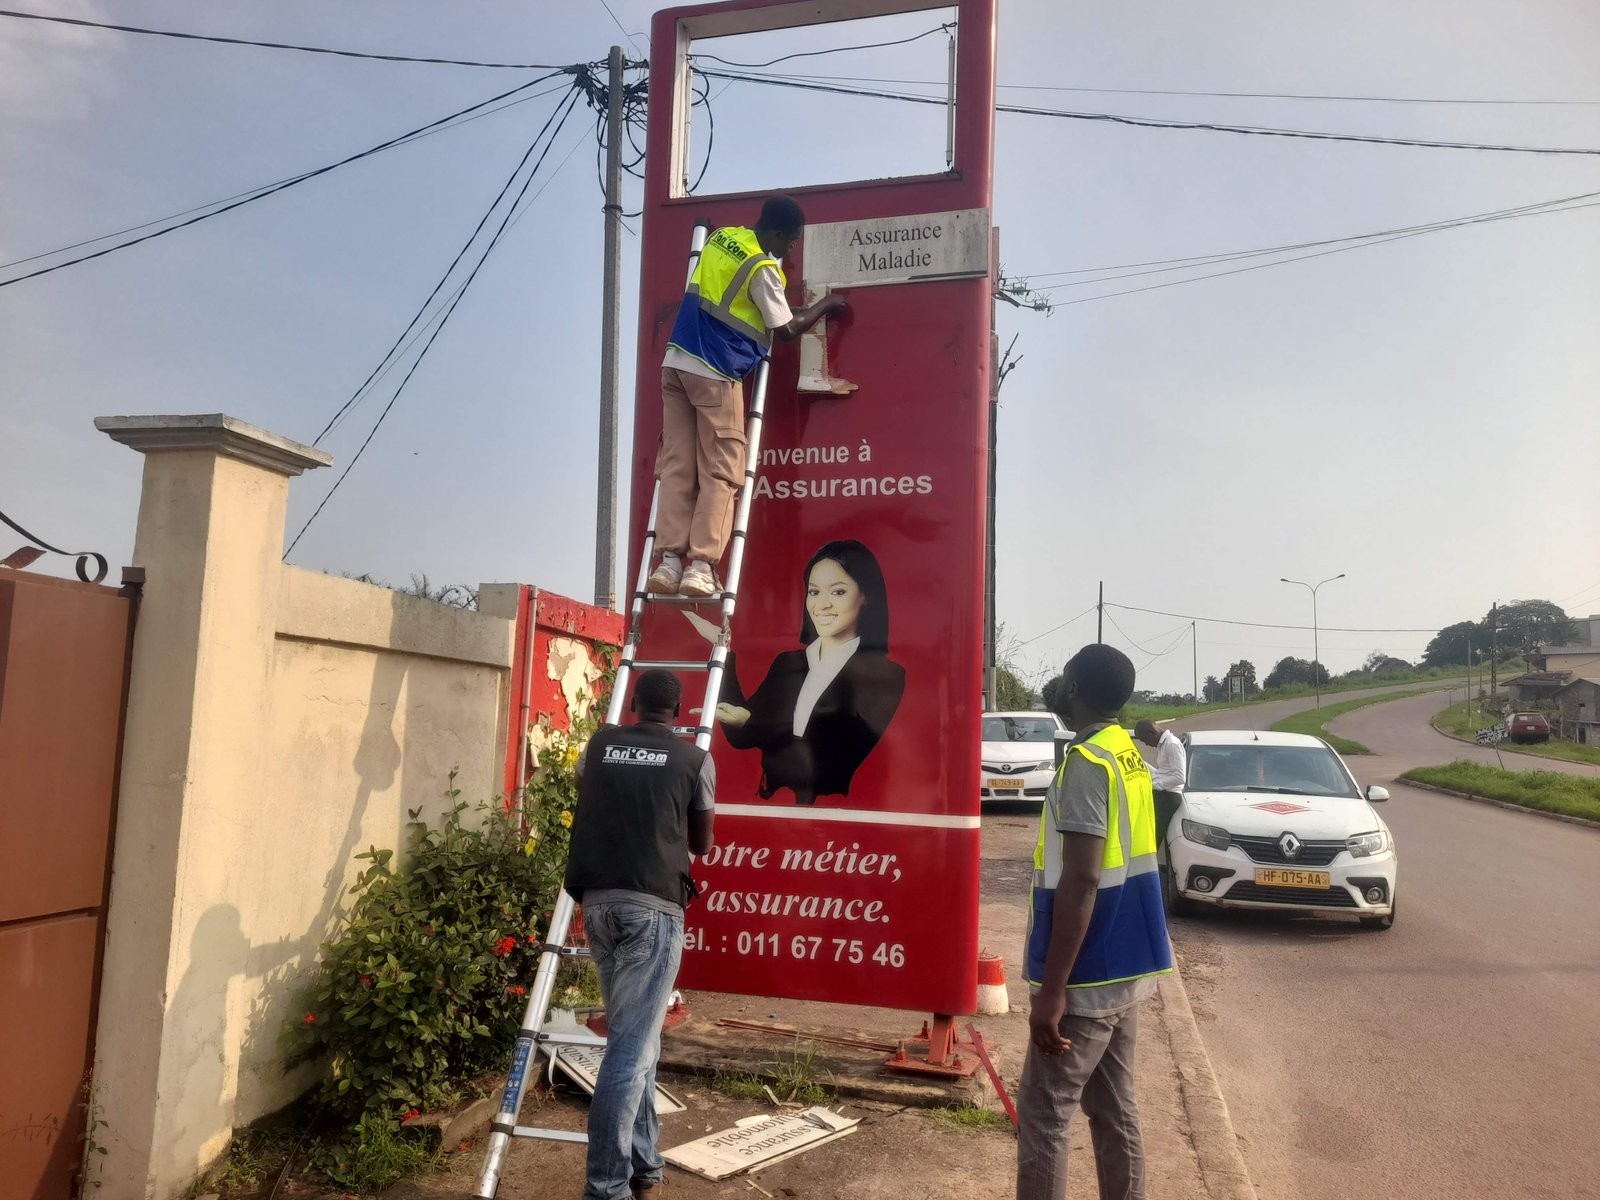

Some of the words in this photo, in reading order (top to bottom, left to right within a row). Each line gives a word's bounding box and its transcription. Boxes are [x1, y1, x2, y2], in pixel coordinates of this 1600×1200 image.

[849, 222, 942, 247] Assurance
[857, 248, 932, 273] Maladie
[858, 438, 872, 463] à
[752, 473, 933, 500] Assurances
[780, 841, 902, 884] métier,
[1263, 870, 1322, 886] HF-075-AA
[686, 879, 890, 924] 'assurance.
[737, 930, 780, 957] 011
[791, 934, 823, 961] 67
[832, 938, 864, 965] 75
[872, 942, 906, 969] 46
